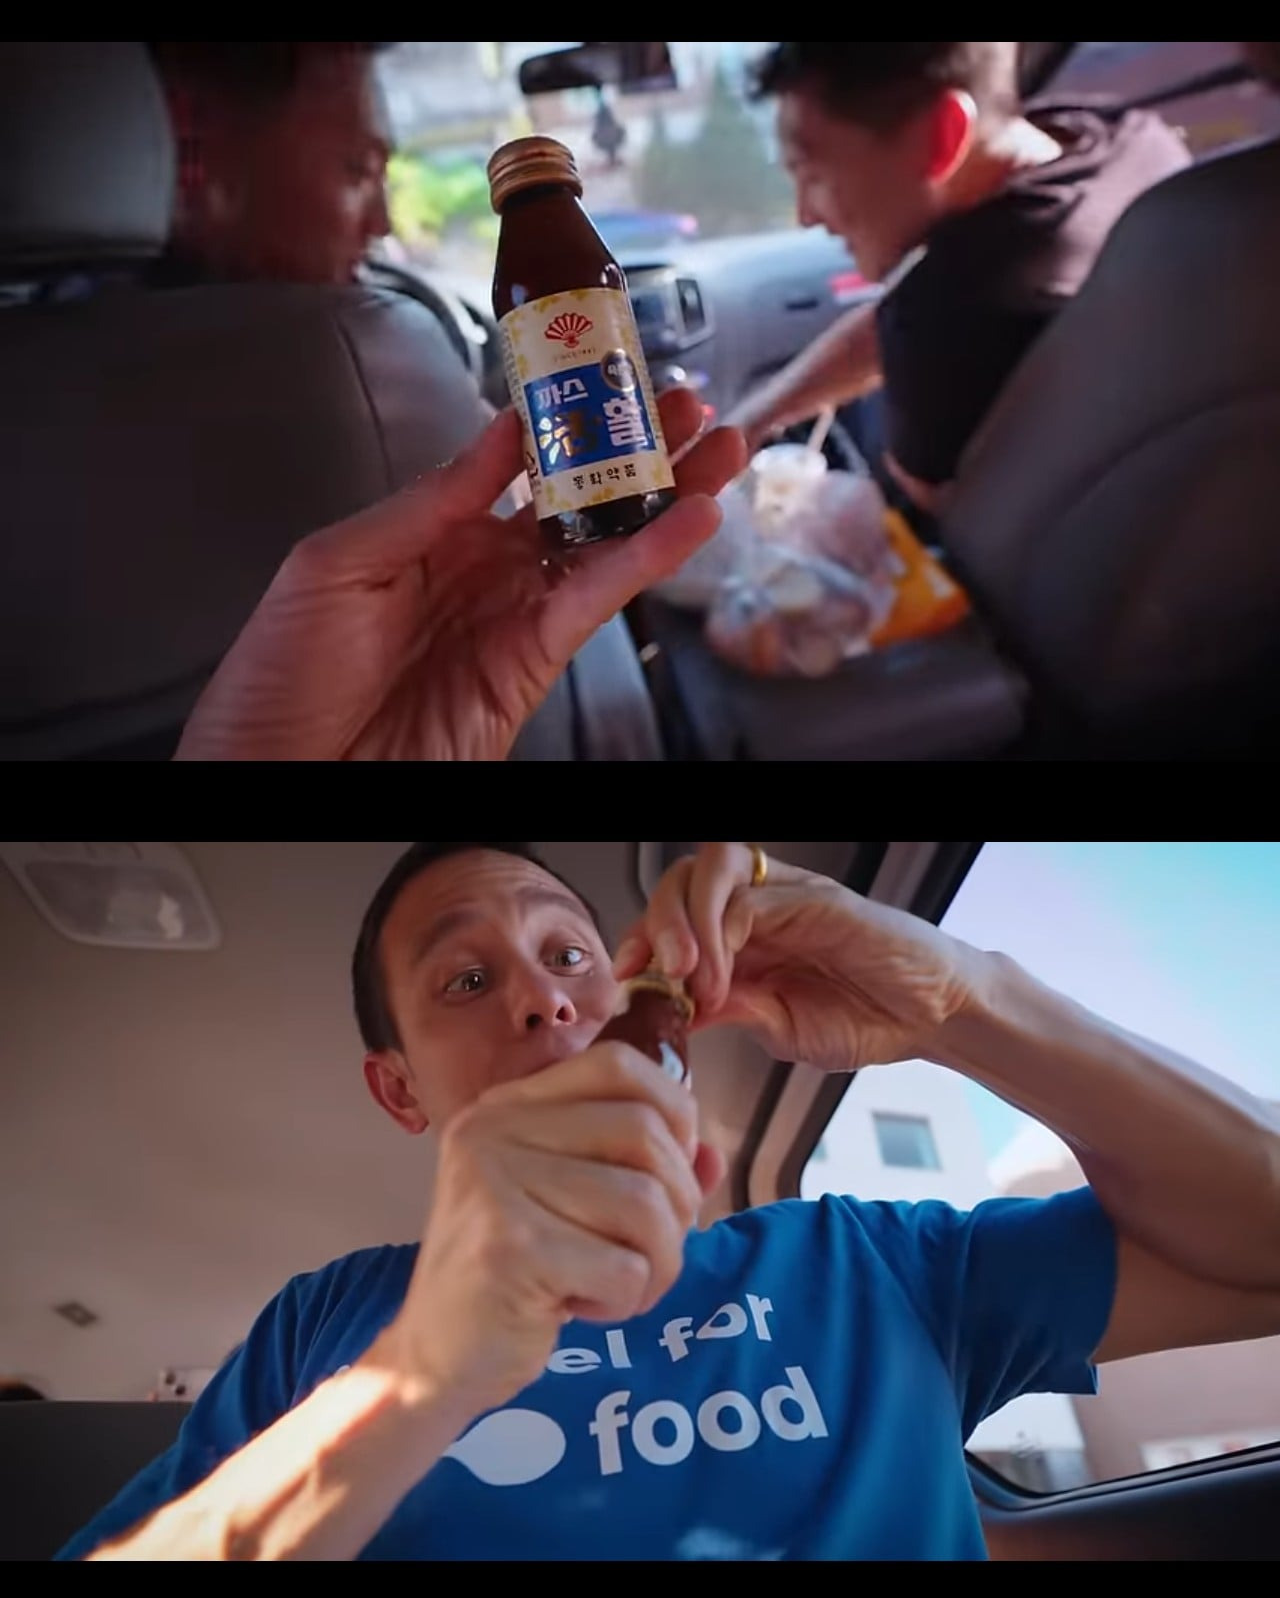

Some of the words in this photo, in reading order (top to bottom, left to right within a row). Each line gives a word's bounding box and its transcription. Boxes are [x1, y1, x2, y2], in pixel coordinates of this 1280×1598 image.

[534, 378, 589, 409] 까스
[603, 392, 649, 448] 활
[659, 1292, 775, 1363] for
[589, 1365, 829, 1476] food
